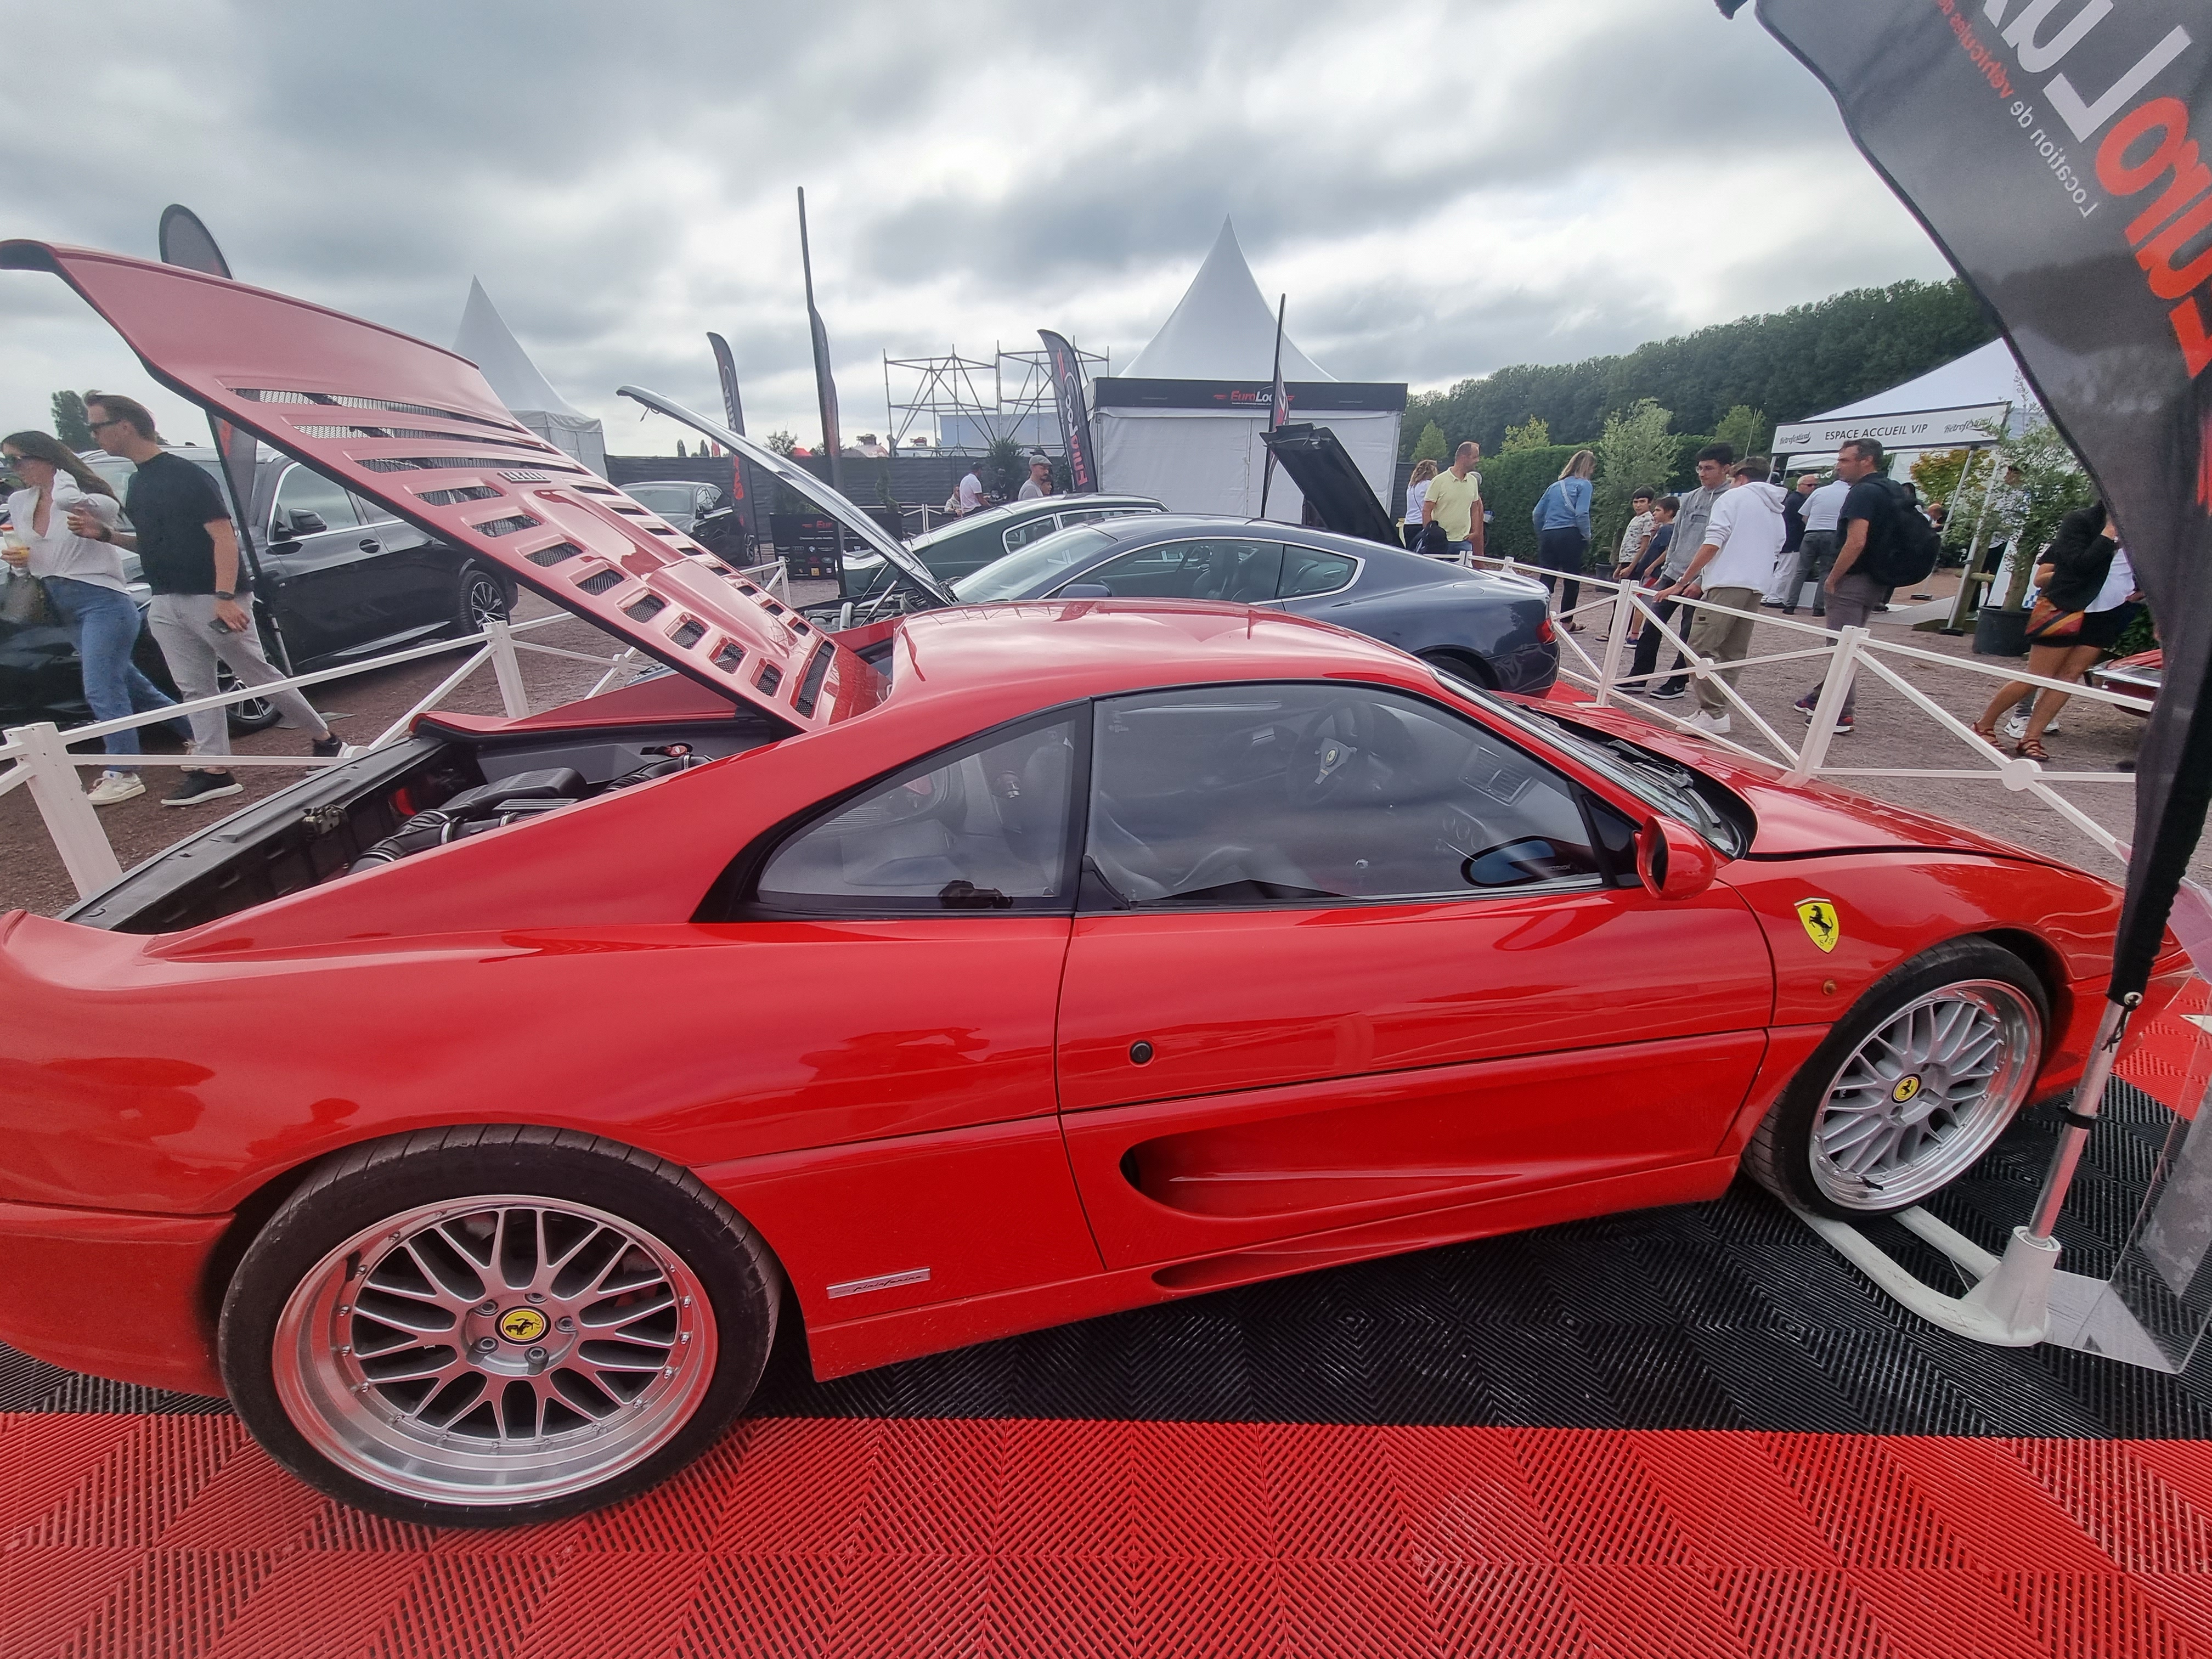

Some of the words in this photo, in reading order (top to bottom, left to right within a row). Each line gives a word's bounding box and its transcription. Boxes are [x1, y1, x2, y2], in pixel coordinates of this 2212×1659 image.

[1825, 428, 1860, 441] ESPACE
[1861, 425, 1907, 438] ACCUEIL
[1911, 424, 1929, 434] VIP
